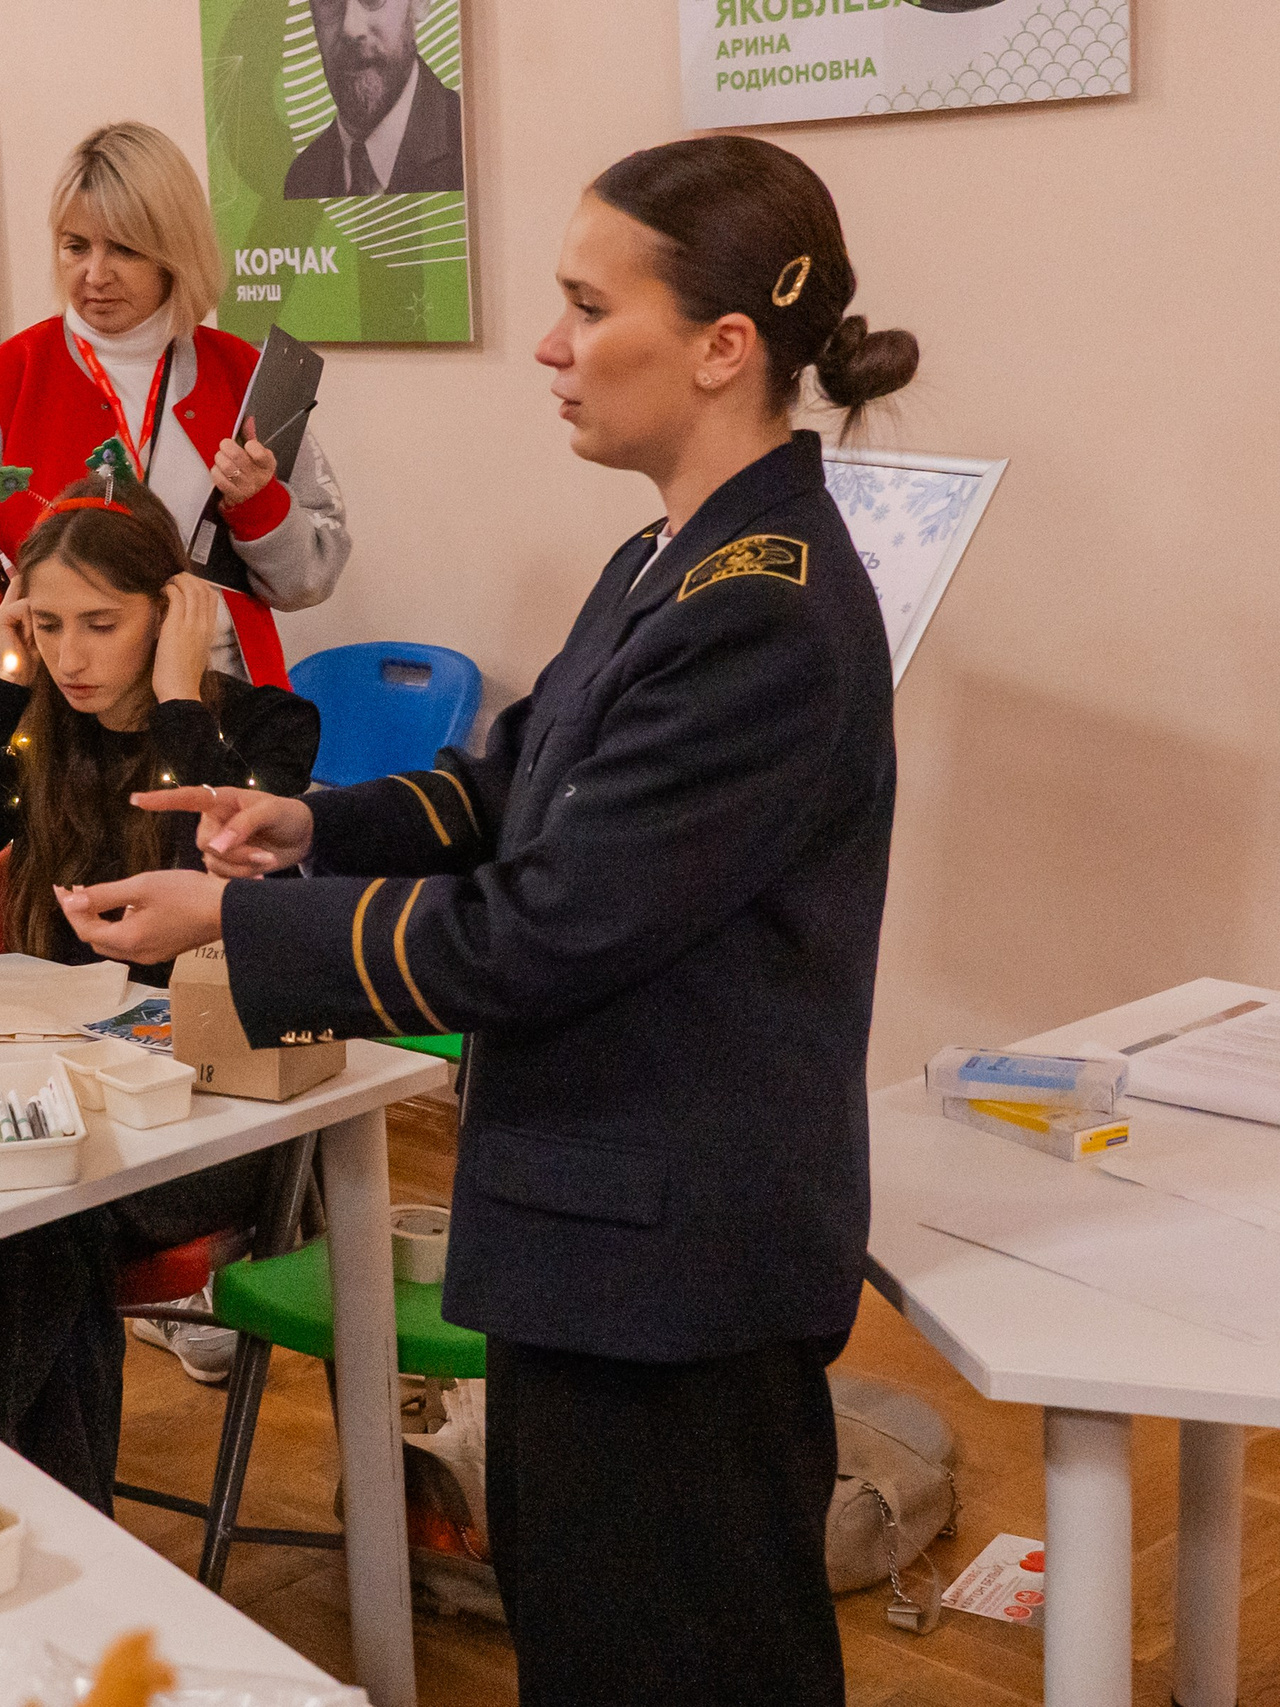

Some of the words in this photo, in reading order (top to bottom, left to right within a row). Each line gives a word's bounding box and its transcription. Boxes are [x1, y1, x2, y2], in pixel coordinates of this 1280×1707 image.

[715, 33, 792, 60] АРИНА
[716, 56, 878, 92] РОДИОНОВНА
[235, 246, 340, 275] КОРЧАК
[236, 284, 282, 301] ЯНУШ
